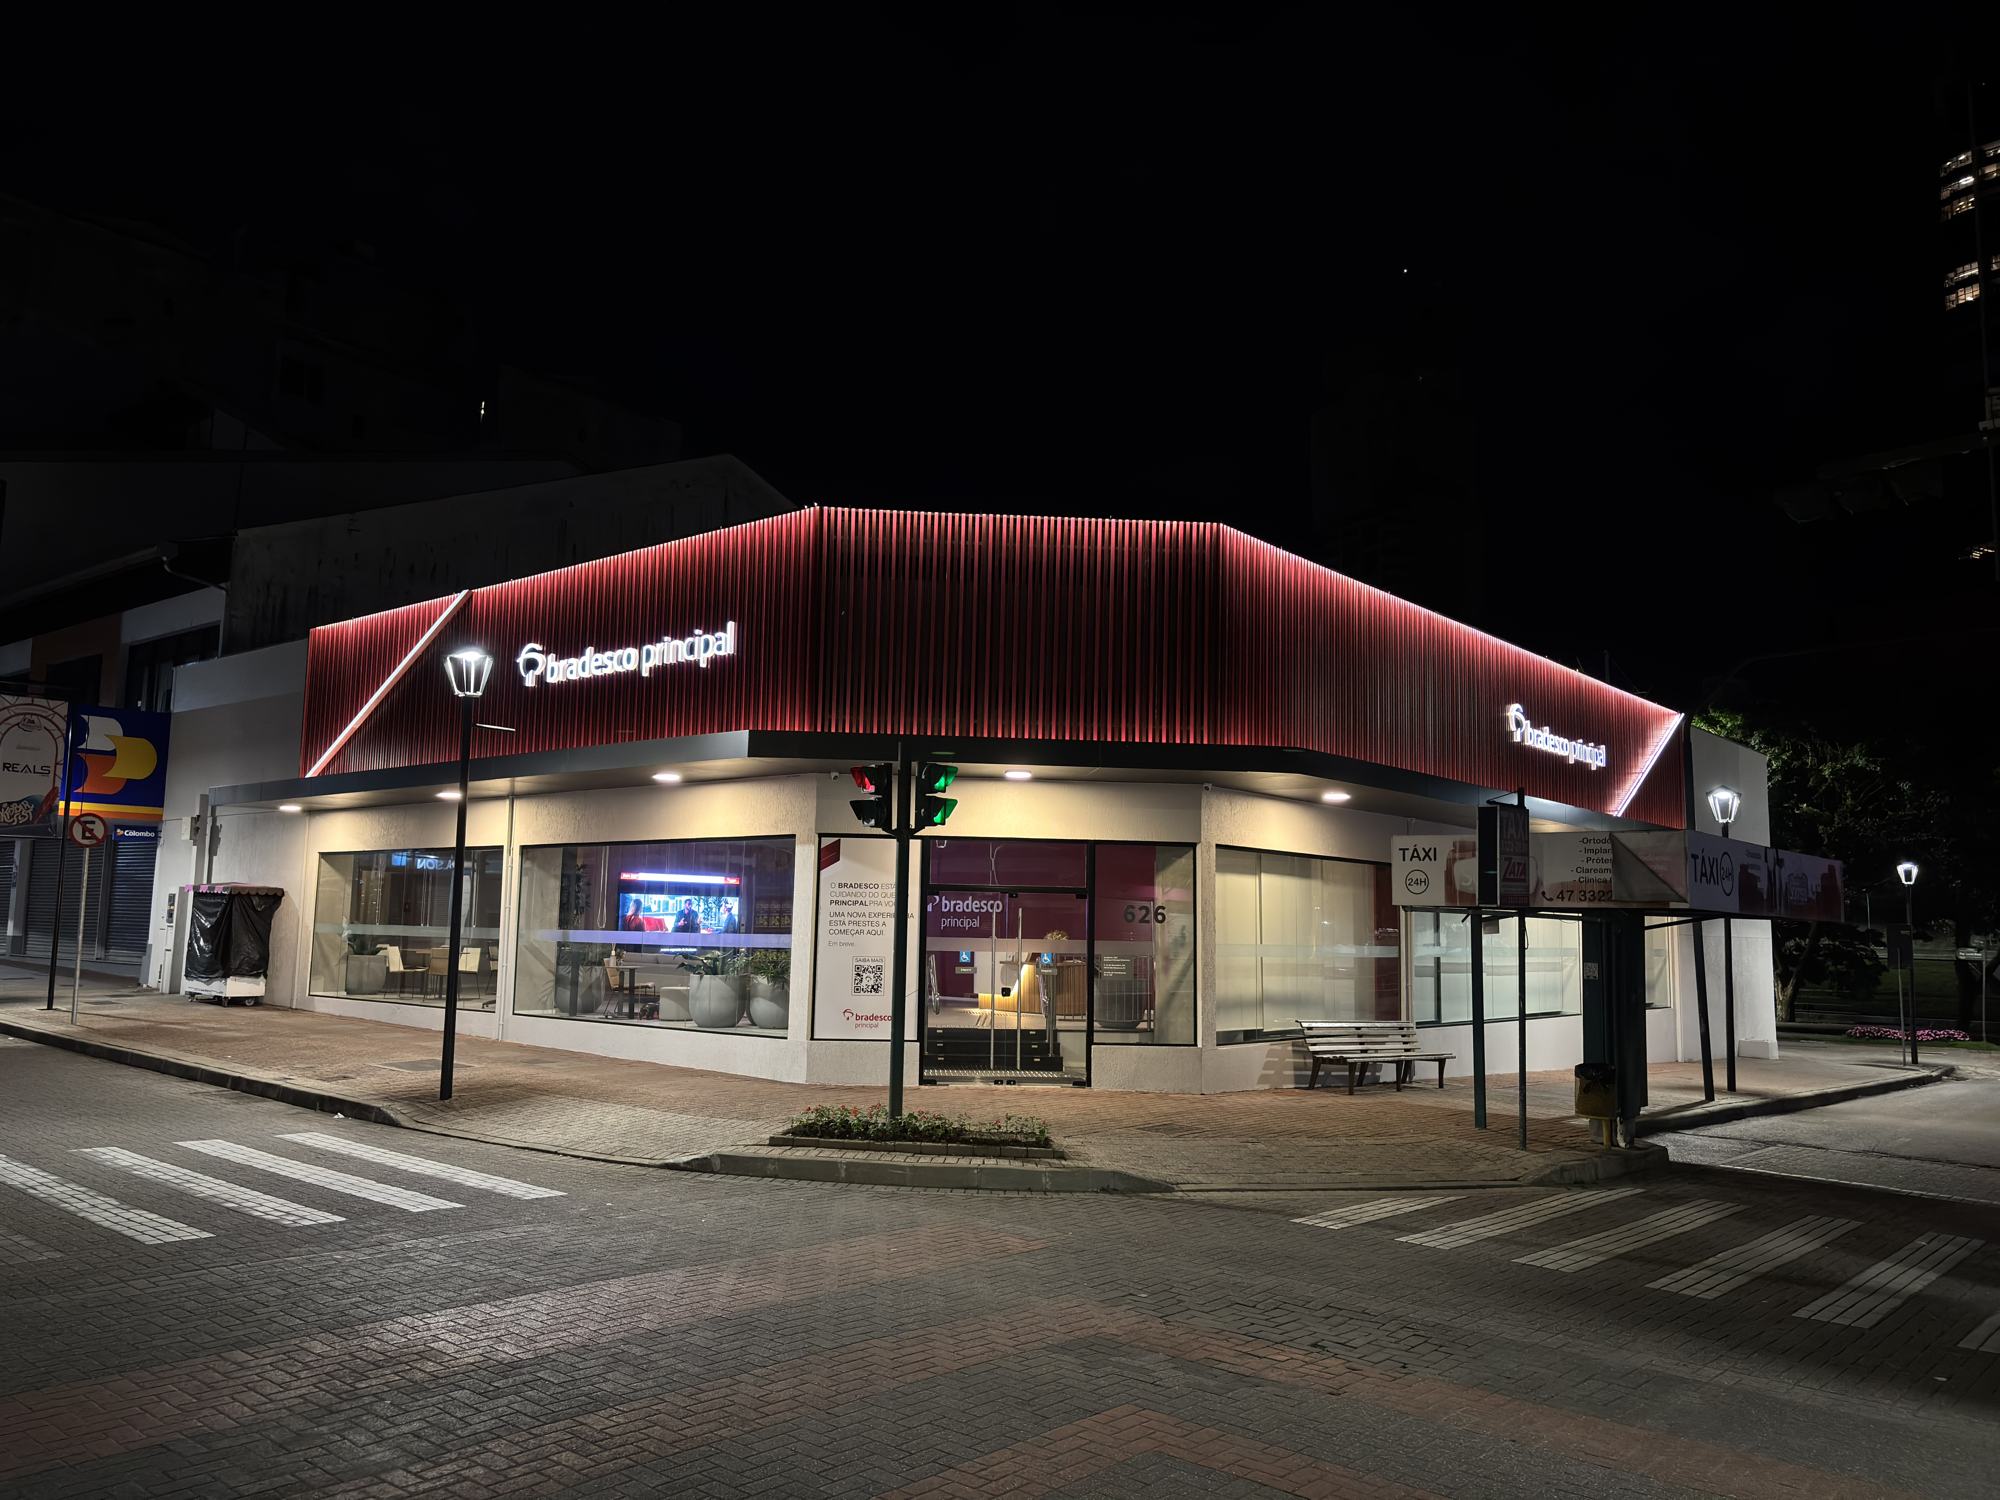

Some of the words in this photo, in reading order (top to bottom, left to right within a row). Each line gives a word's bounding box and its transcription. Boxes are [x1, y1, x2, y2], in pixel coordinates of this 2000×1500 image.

[546, 647, 639, 684] bradesco
[642, 620, 737, 677] principal
[1525, 720, 1569, 757] bradesco
[1568, 739, 1606, 771] principal
[2, 761, 52, 776] REALS
[124, 829, 155, 838] Colombo
[1398, 844, 1437, 862] TÁXI
[1691, 847, 1719, 886] TÁXI
[838, 882, 880, 890] BRADESCO
[1407, 878, 1427, 887] 24H
[1556, 889, 1575, 902] 47
[941, 895, 1003, 913] bradesco
[1124, 904, 1167, 924] 626
[941, 915, 980, 931] principal
[855, 1013, 893, 1022] bradesco
[854, 1022, 880, 1030] principal
